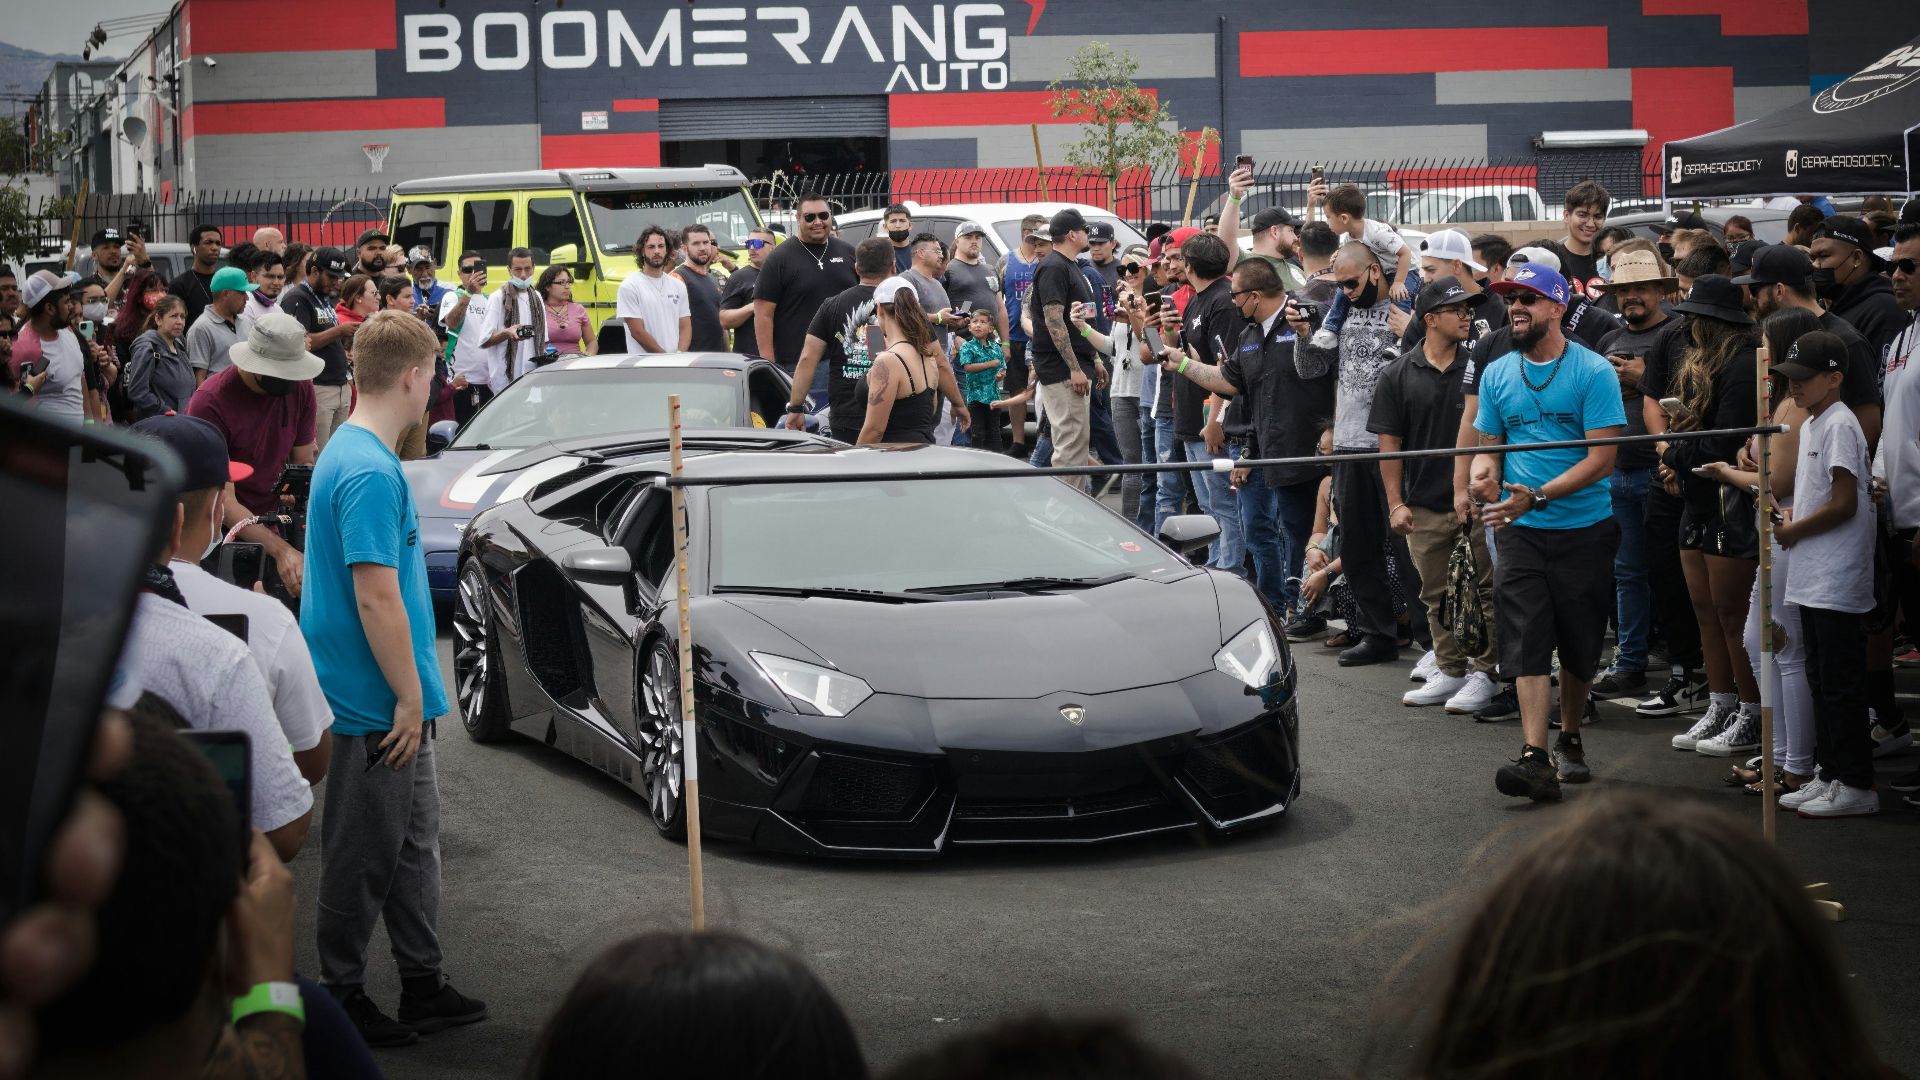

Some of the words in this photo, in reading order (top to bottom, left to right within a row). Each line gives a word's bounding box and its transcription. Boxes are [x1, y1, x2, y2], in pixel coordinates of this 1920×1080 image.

[404, 3, 1008, 73] BOOMERANG
[884, 61, 1008, 92] AUTO
[1684, 159, 1763, 175] GEARHEADSOCIETY
[653, 201, 675, 209] AUTO
[677, 200, 713, 208] GALLERY
[1506, 412, 1575, 427] ELITE
